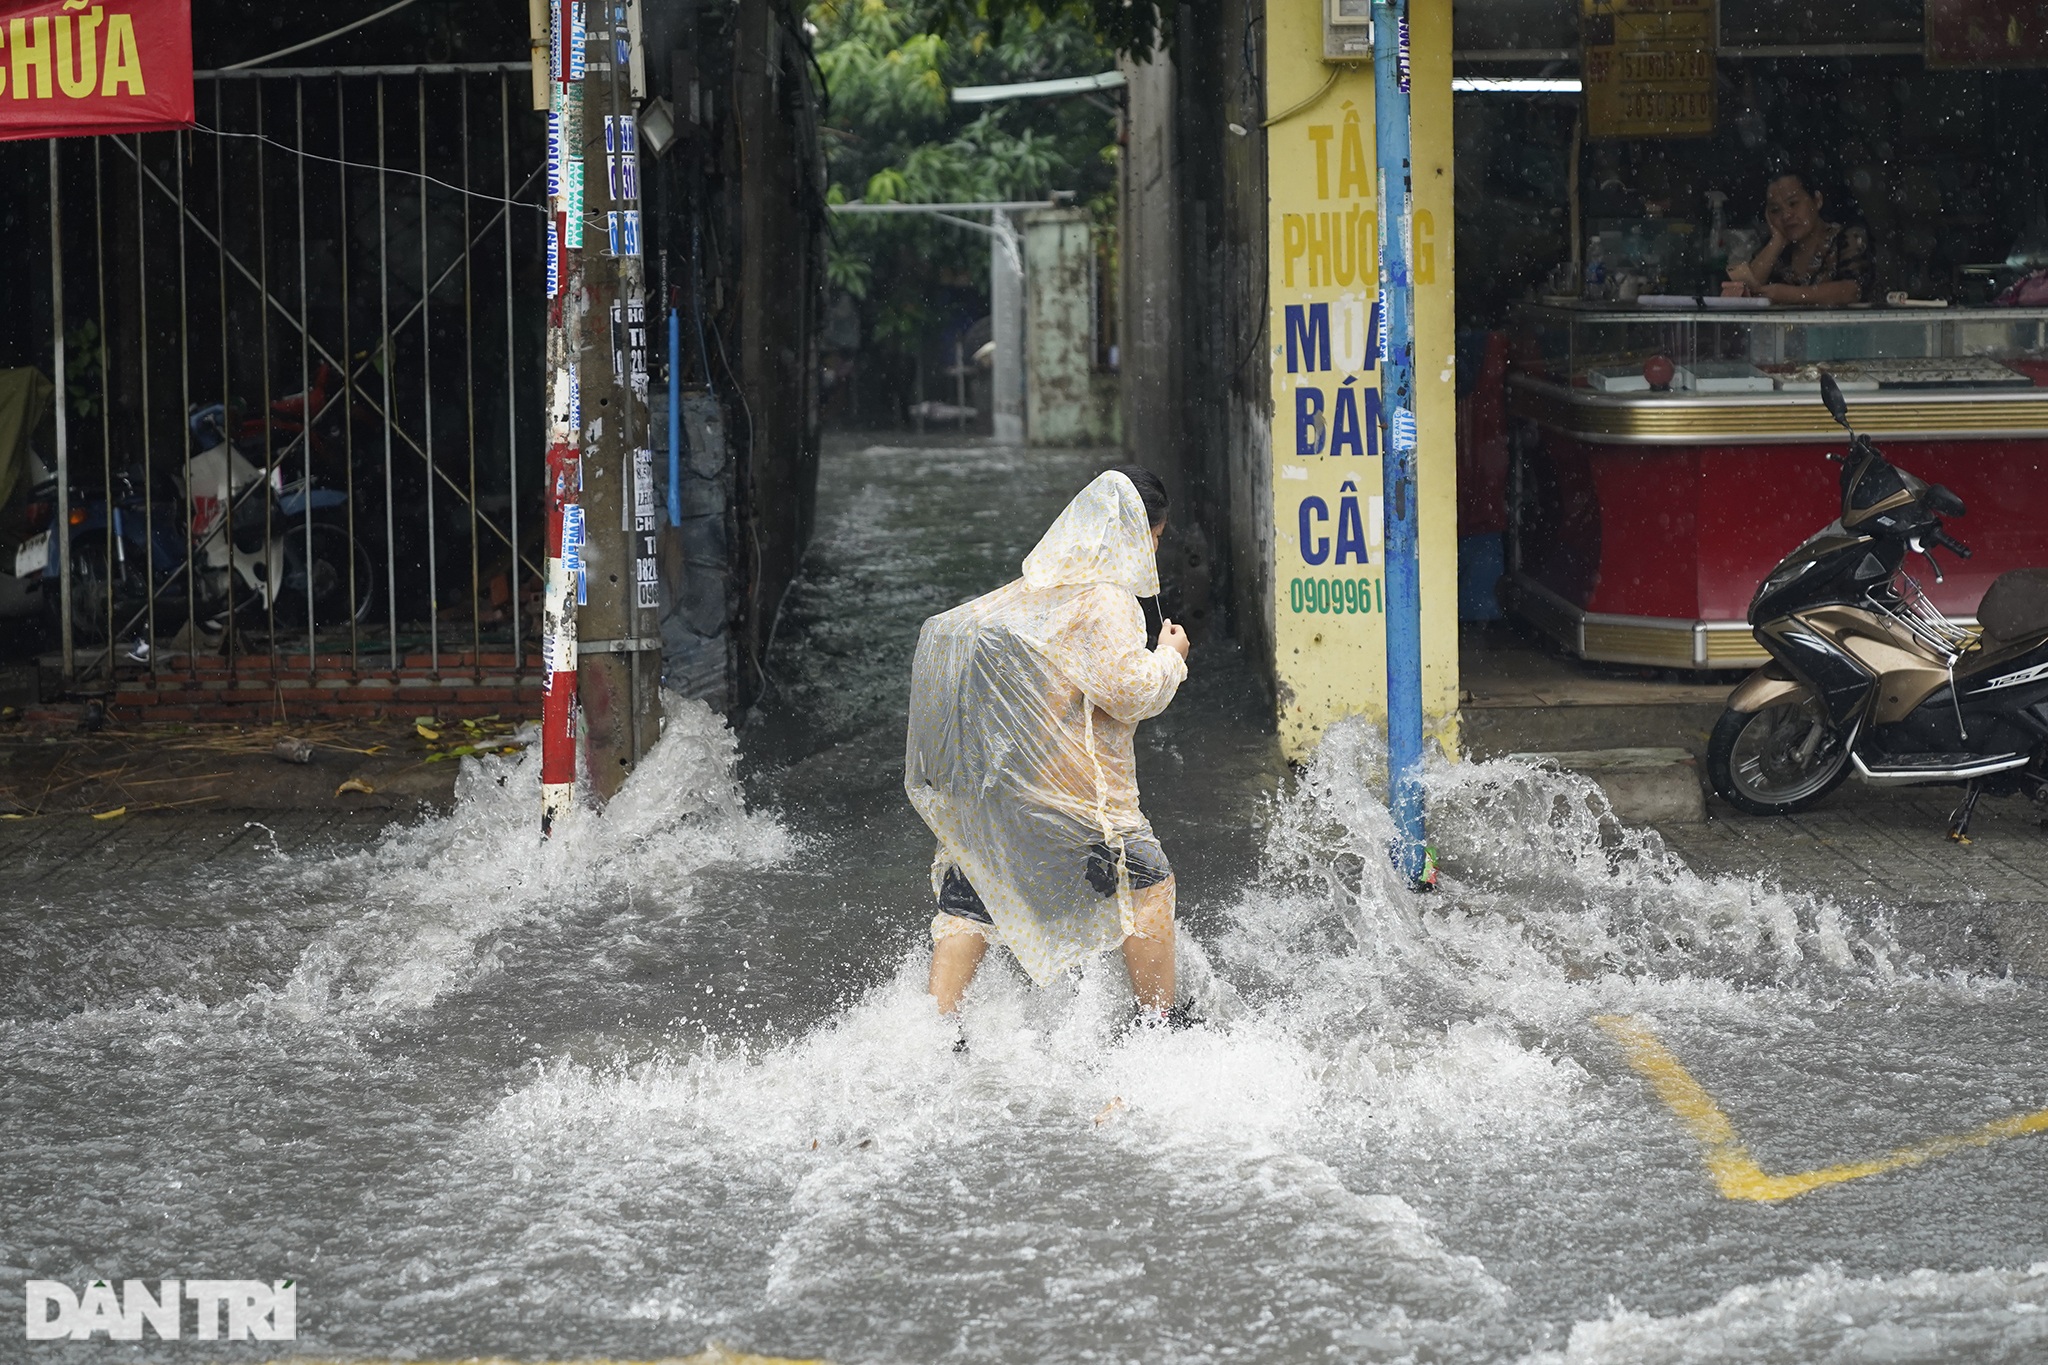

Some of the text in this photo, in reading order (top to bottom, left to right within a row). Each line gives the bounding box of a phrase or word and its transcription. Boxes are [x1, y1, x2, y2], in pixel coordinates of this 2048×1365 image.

[0, 0, 146, 100] HỮA
[1309, 99, 1378, 200] TẤ
[1282, 203, 1436, 299] PHƯỢG
